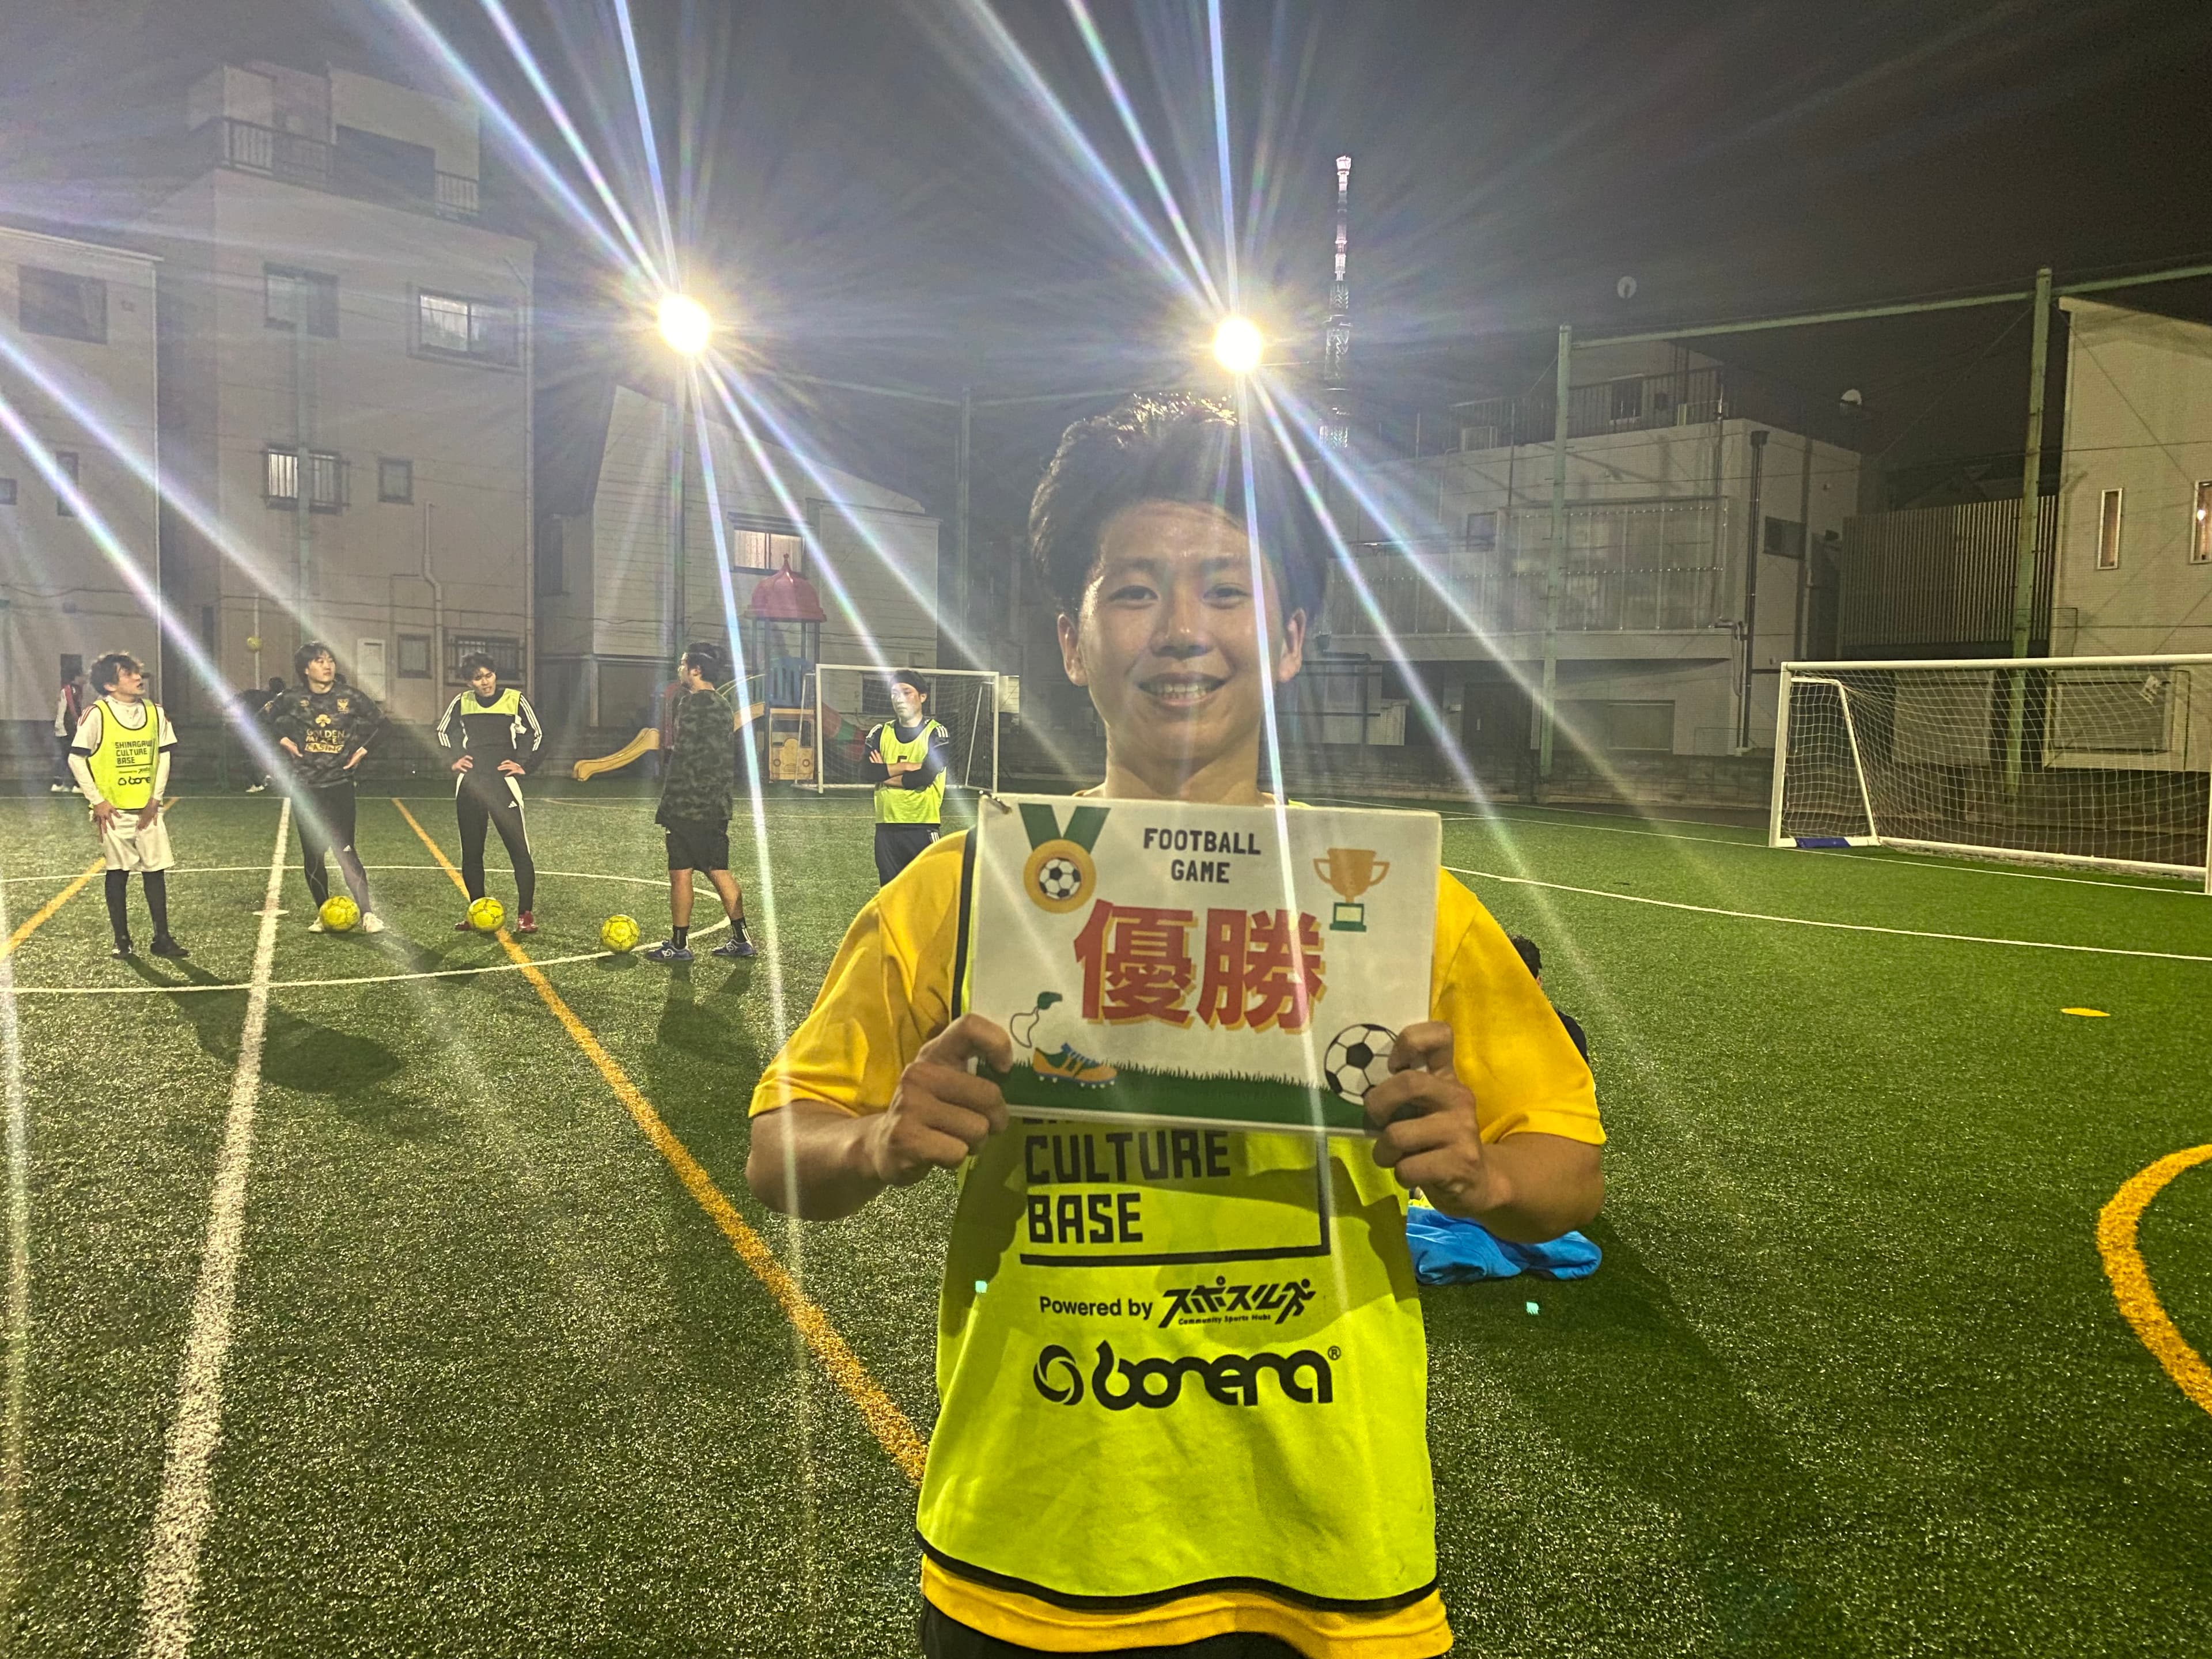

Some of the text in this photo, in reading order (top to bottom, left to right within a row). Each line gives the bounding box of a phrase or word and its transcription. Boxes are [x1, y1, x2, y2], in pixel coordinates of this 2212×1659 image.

[306, 729, 344, 738] GOLDEN
[116, 748, 148, 757] CULTURE
[116, 756, 135, 764] BASE
[1143, 827, 1261, 855] FOOTBALL
[1171, 859, 1230, 884] GAME
[1074, 899, 1327, 1035] 優勝
[1025, 1129, 1230, 1184] CULTURE
[1027, 1192, 1143, 1244] BASE
[1039, 1296, 1153, 1320] Powered by
[1225, 1315, 1249, 1323] Sports
